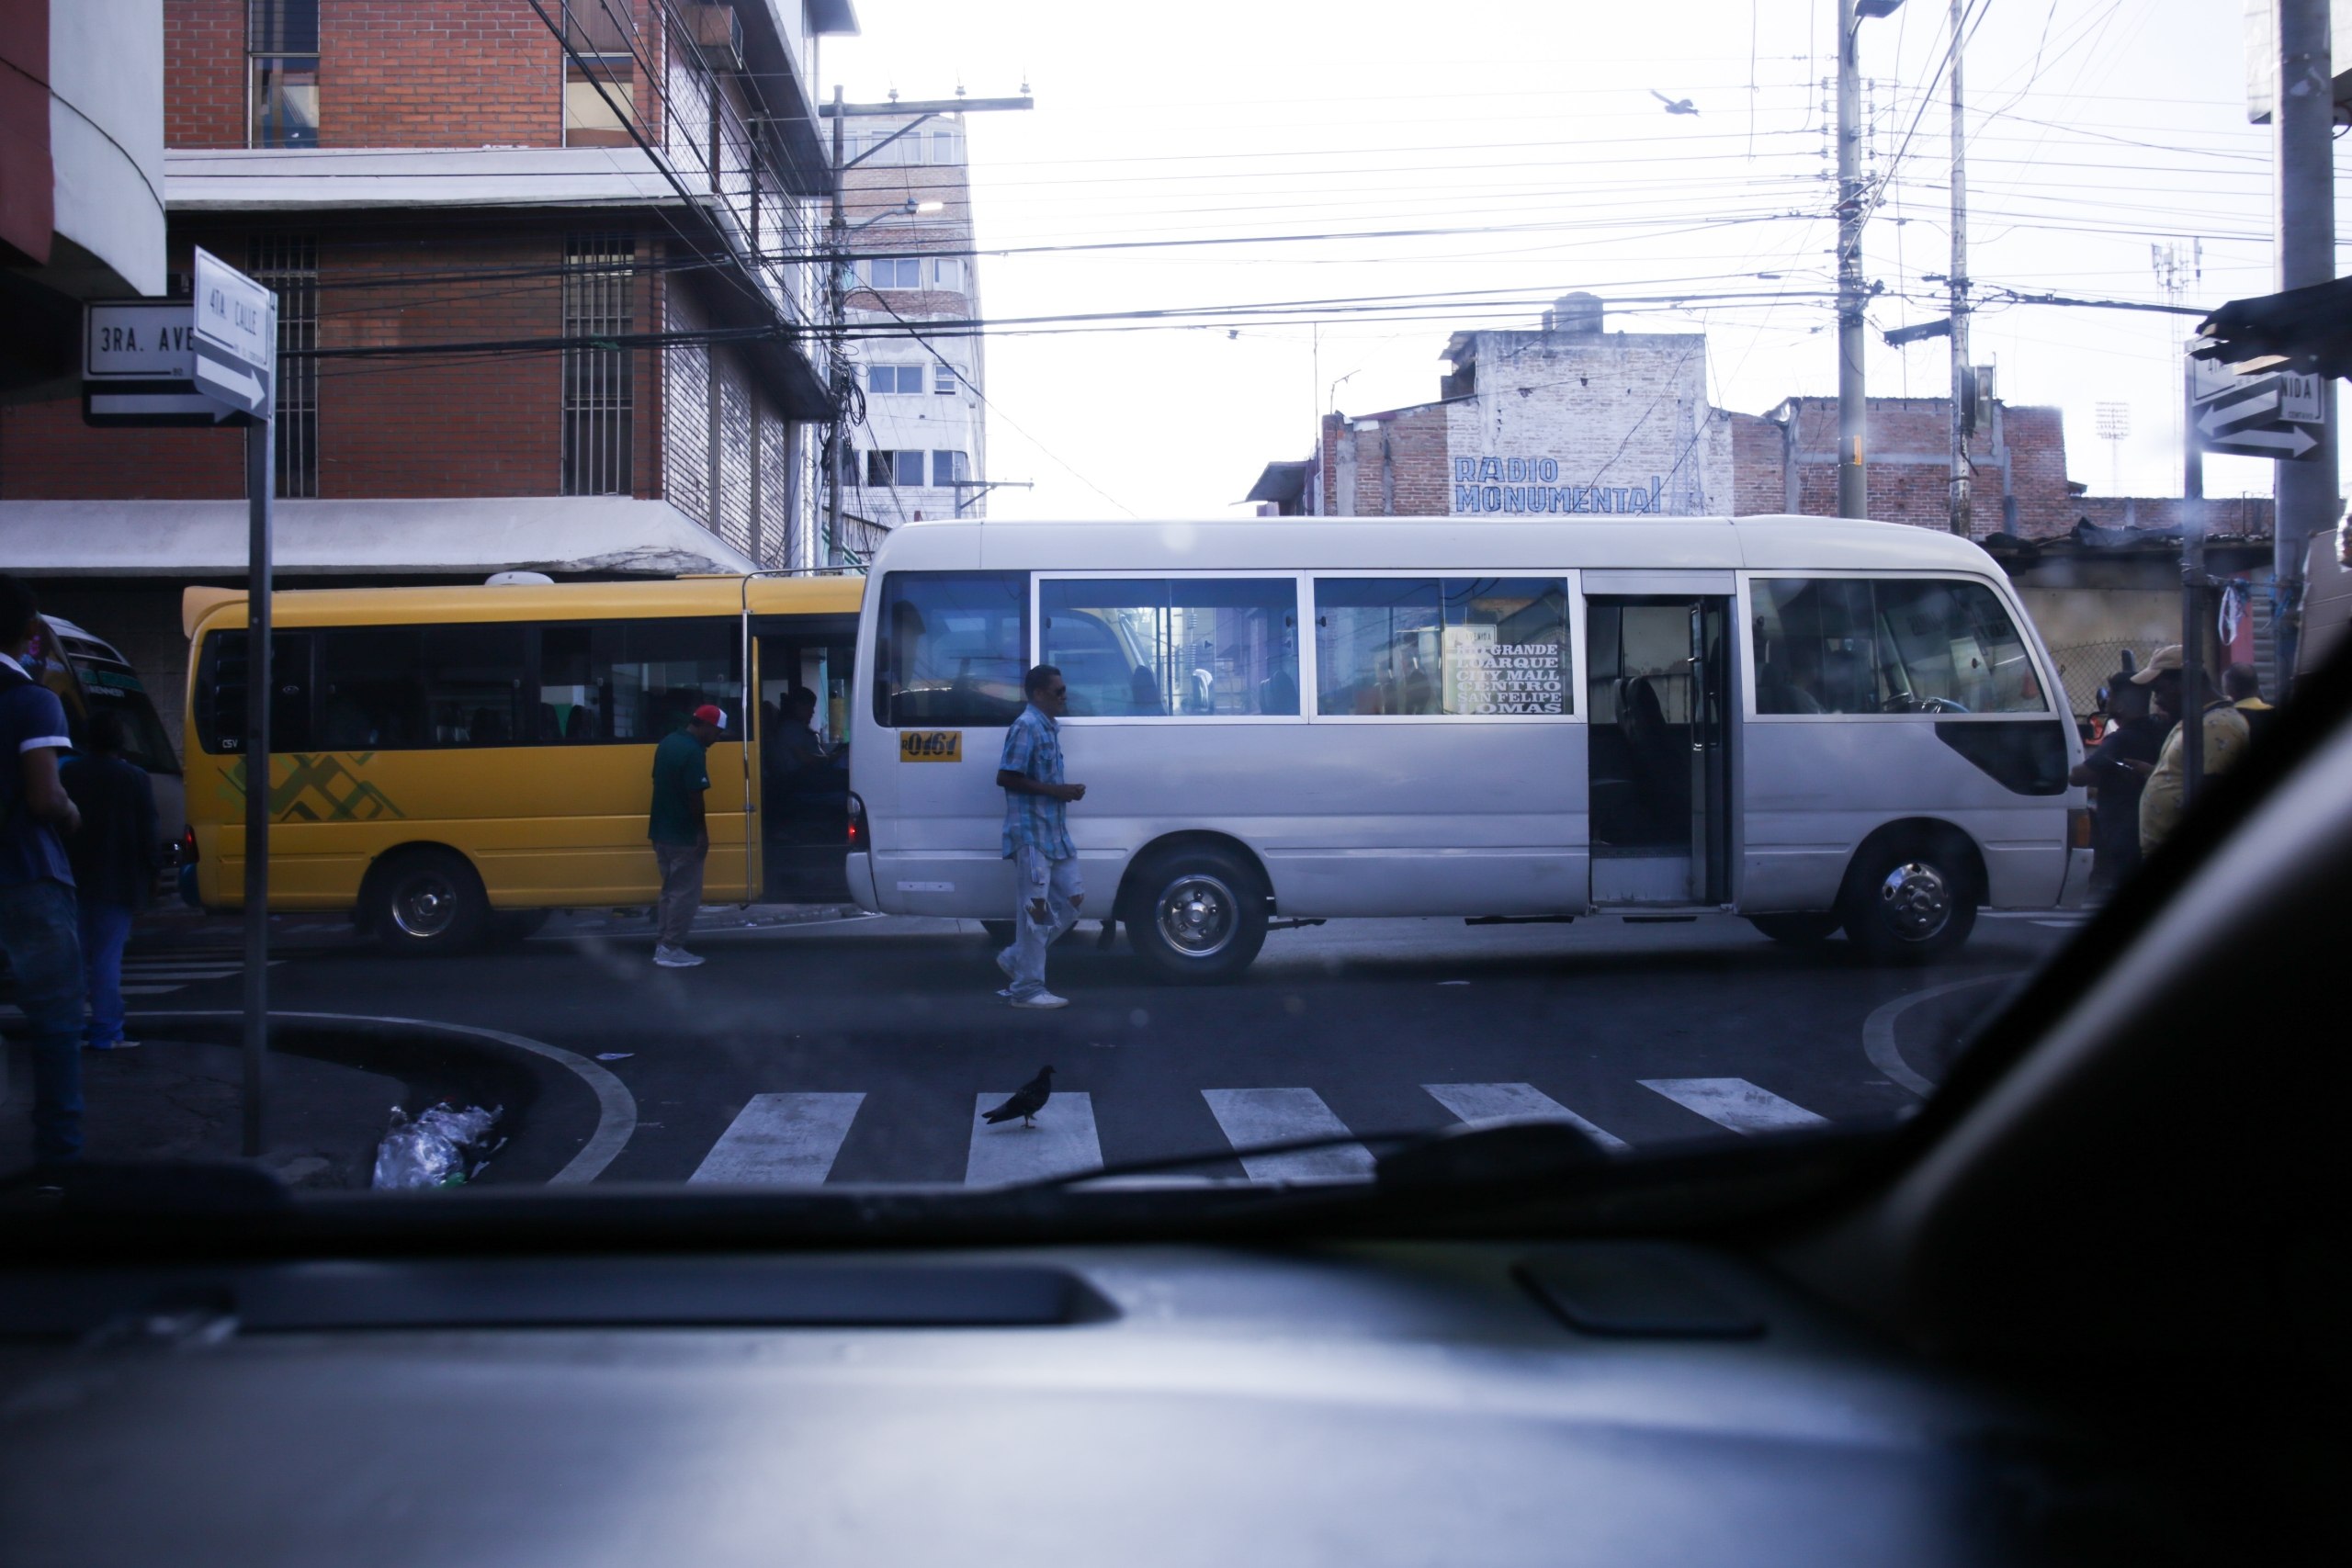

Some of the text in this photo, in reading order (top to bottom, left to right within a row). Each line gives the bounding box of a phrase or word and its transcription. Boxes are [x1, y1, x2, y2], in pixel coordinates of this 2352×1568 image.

[235, 300, 257, 336] CALLE
[101, 327, 144, 352] 3RA.
[1454, 457, 1558, 483] RADIO
[1490, 644, 1558, 655] GRANDE
[1456, 657, 1558, 669] LOARQUE
[1456, 670, 1559, 682] CITY MALL
[1457, 682, 1561, 691] CENTRO
[1457, 693, 1562, 703] SAN FELIPE
